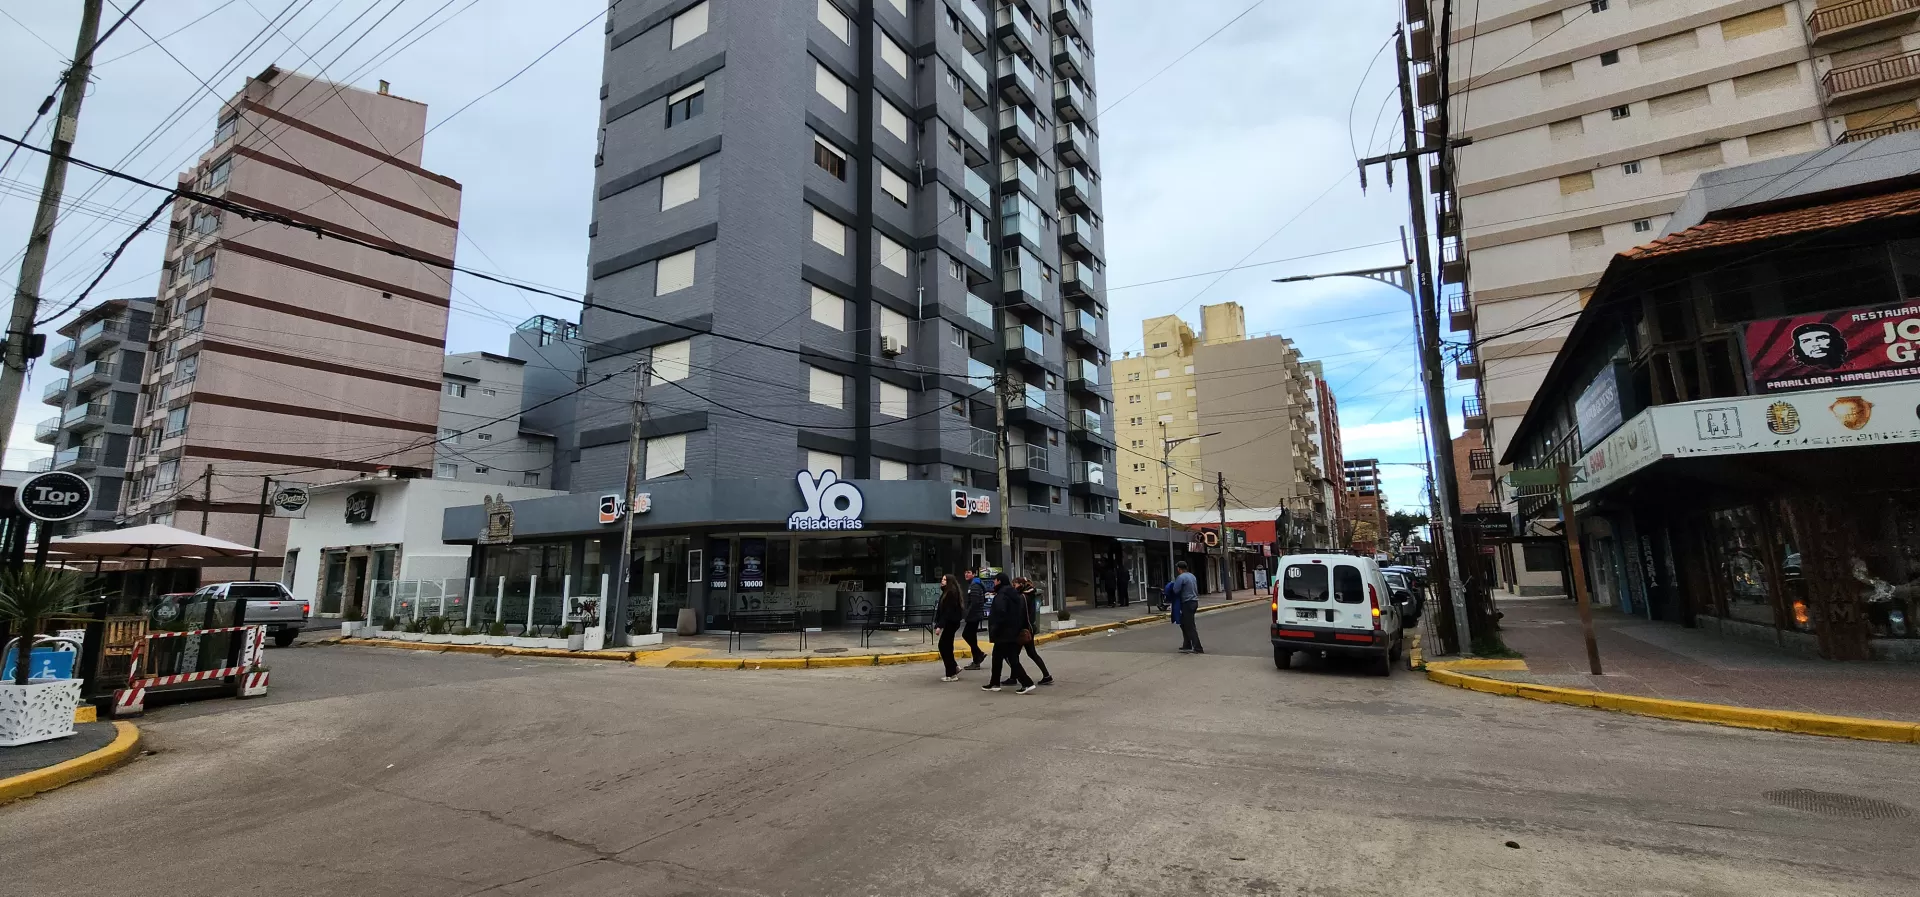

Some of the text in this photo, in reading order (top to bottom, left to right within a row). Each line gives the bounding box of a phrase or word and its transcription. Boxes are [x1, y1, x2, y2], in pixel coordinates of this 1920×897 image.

[1852, 306, 1920, 322] RESTAURA
[1887, 341, 1920, 363] G
[1767, 376, 1833, 390] PARRILLADA
[35, 486, 80, 506] Top
[788, 517, 863, 530] Heladerías
[1288, 567, 1302, 578] 110
